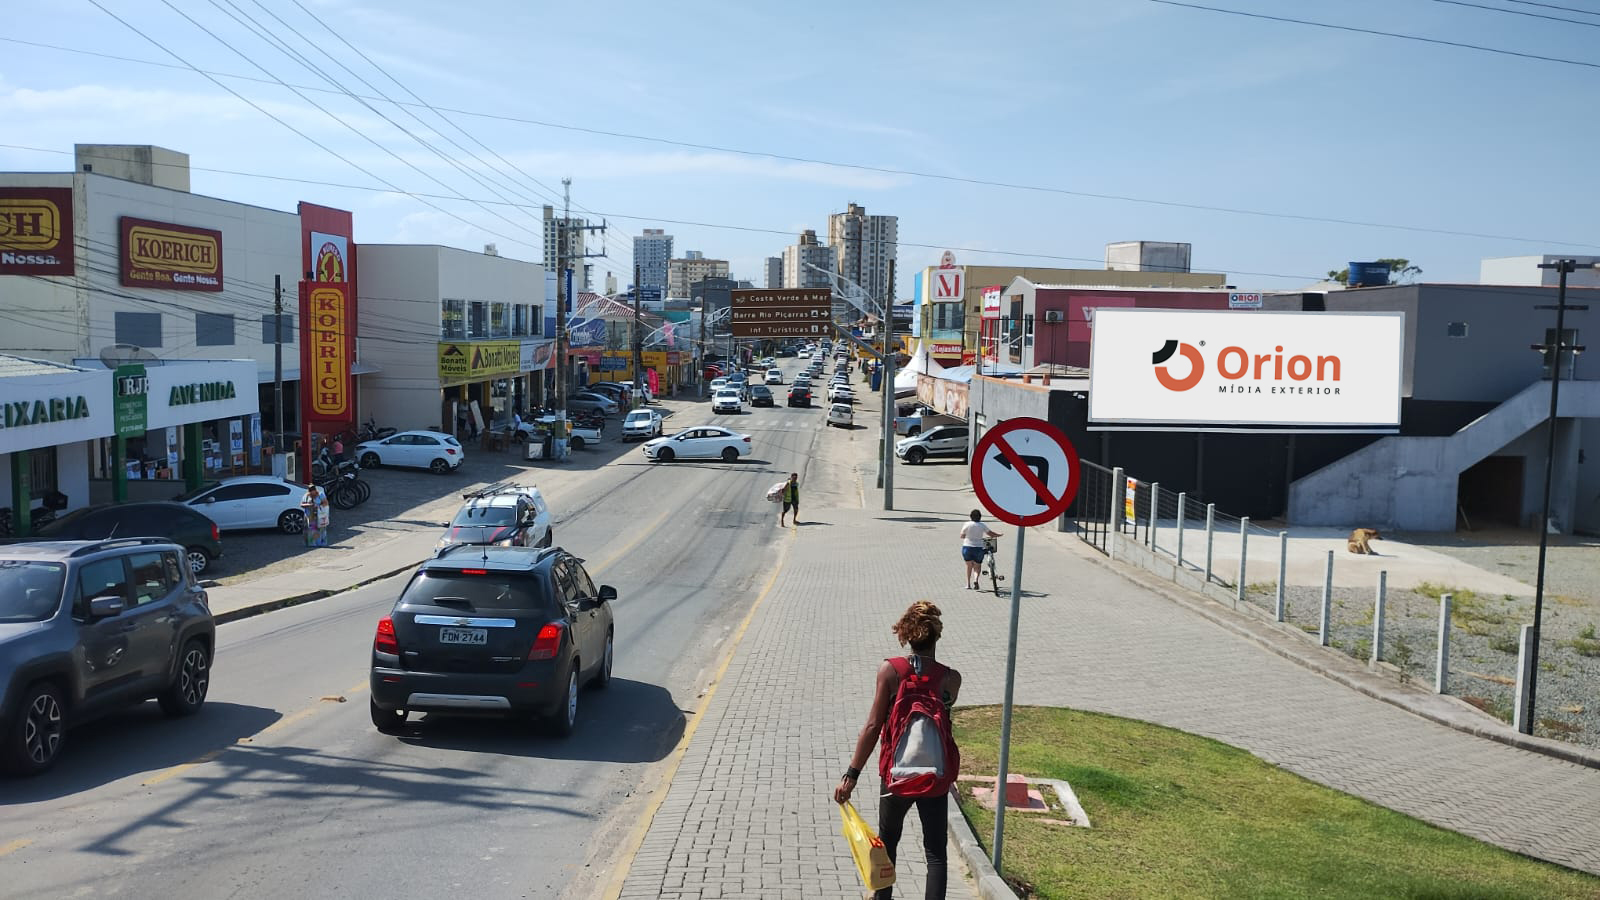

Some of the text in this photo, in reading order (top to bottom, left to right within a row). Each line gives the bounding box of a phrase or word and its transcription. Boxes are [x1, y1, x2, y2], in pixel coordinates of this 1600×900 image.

[136, 237, 212, 264] KOERICH
[1, 252, 60, 265] Nossa.
[173, 272, 195, 284] Gente
[1231, 294, 1259, 302] ORION
[775, 311, 809, 319] Piçarras
[319, 298, 339, 405] KOERICH
[441, 356, 467, 364] Bonatti
[1217, 345, 1341, 381] Orion
[168, 380, 236, 406] AVENIDA
[1218, 384, 1341, 395] MÍDIA EXTERIOR
[0, 395, 90, 429] IXARIA
